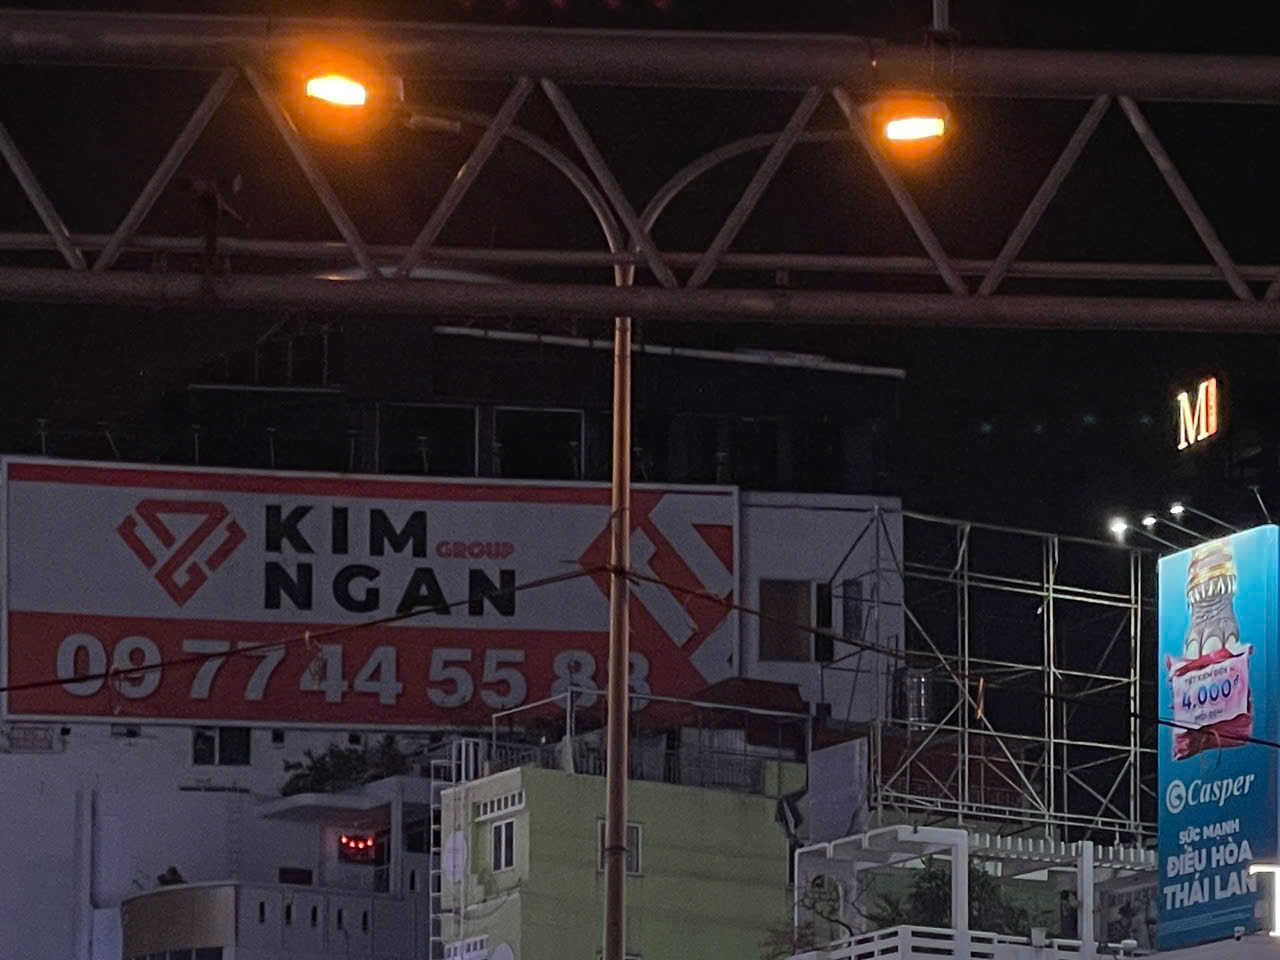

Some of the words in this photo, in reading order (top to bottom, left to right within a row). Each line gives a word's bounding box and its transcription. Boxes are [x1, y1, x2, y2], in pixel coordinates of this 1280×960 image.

[264, 504, 429, 558] KIM
[436, 539, 515, 560] GROUP
[264, 562, 516, 617] NGAN
[56, 633, 161, 699] 09
[182, 640, 287, 702] 77
[299, 643, 403, 706] 44
[426, 647, 526, 709] 55
[1187, 773, 1255, 807] Casper
[1211, 836, 1254, 868] HÒA
[1215, 868, 1257, 900] LAN
